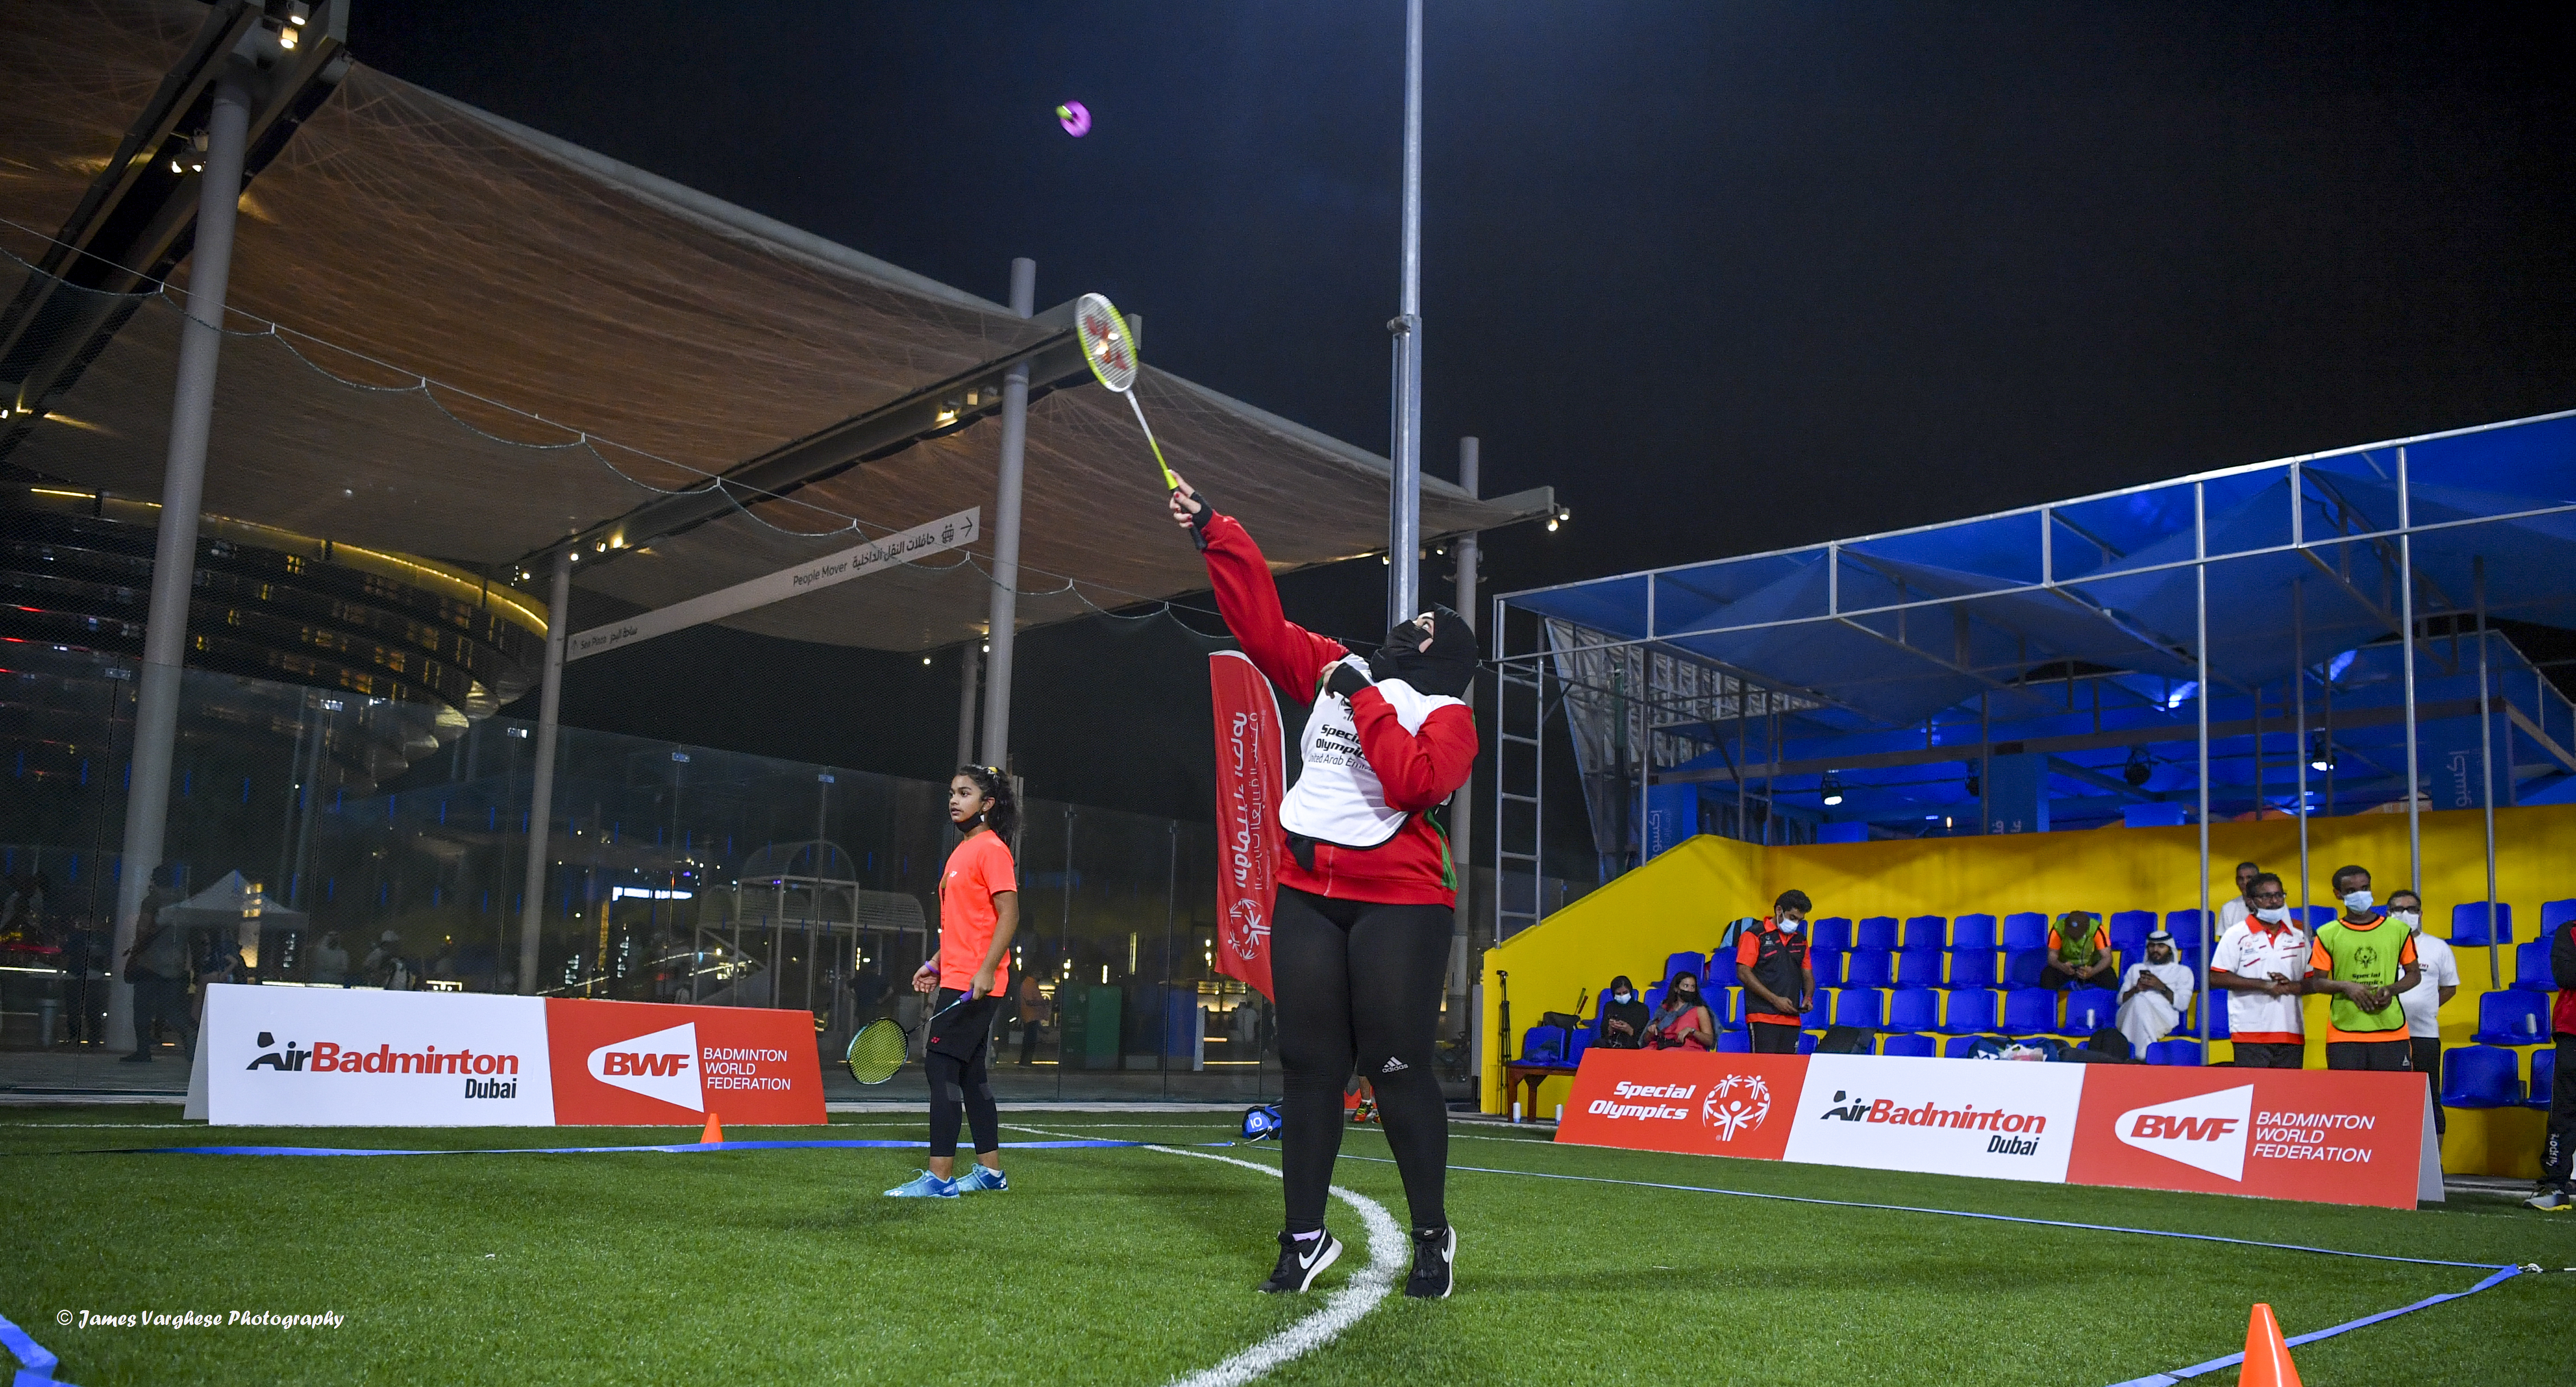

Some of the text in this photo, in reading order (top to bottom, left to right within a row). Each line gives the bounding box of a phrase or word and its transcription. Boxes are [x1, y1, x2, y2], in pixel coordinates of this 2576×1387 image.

[793, 562, 848, 587] People Mover
[1320, 724, 1361, 744] Specia
[1316, 738, 1366, 760] Olympic
[1323, 754, 1344, 765] Arab
[246, 1032, 519, 1075] AirBadminton
[703, 1047, 787, 1062] BADMINTON
[603, 1052, 690, 1077] BWF
[705, 1062, 756, 1076] WORLD
[1381, 1064, 1409, 1073] adidas
[464, 1077, 517, 1099] Dubai
[707, 1077, 791, 1090] FEDERATION
[1613, 1081, 1697, 1100] Special
[1588, 1099, 1689, 1121] Olympics
[1820, 1090, 2047, 1134] AirBadminton
[2130, 1114, 2240, 1142] BWF
[2256, 1111, 2376, 1131] BADMINTON
[1987, 1135, 2040, 1156] Dubai
[2255, 1127, 2325, 1144] WORLD
[2253, 1143, 2372, 1164] FEDERATION
